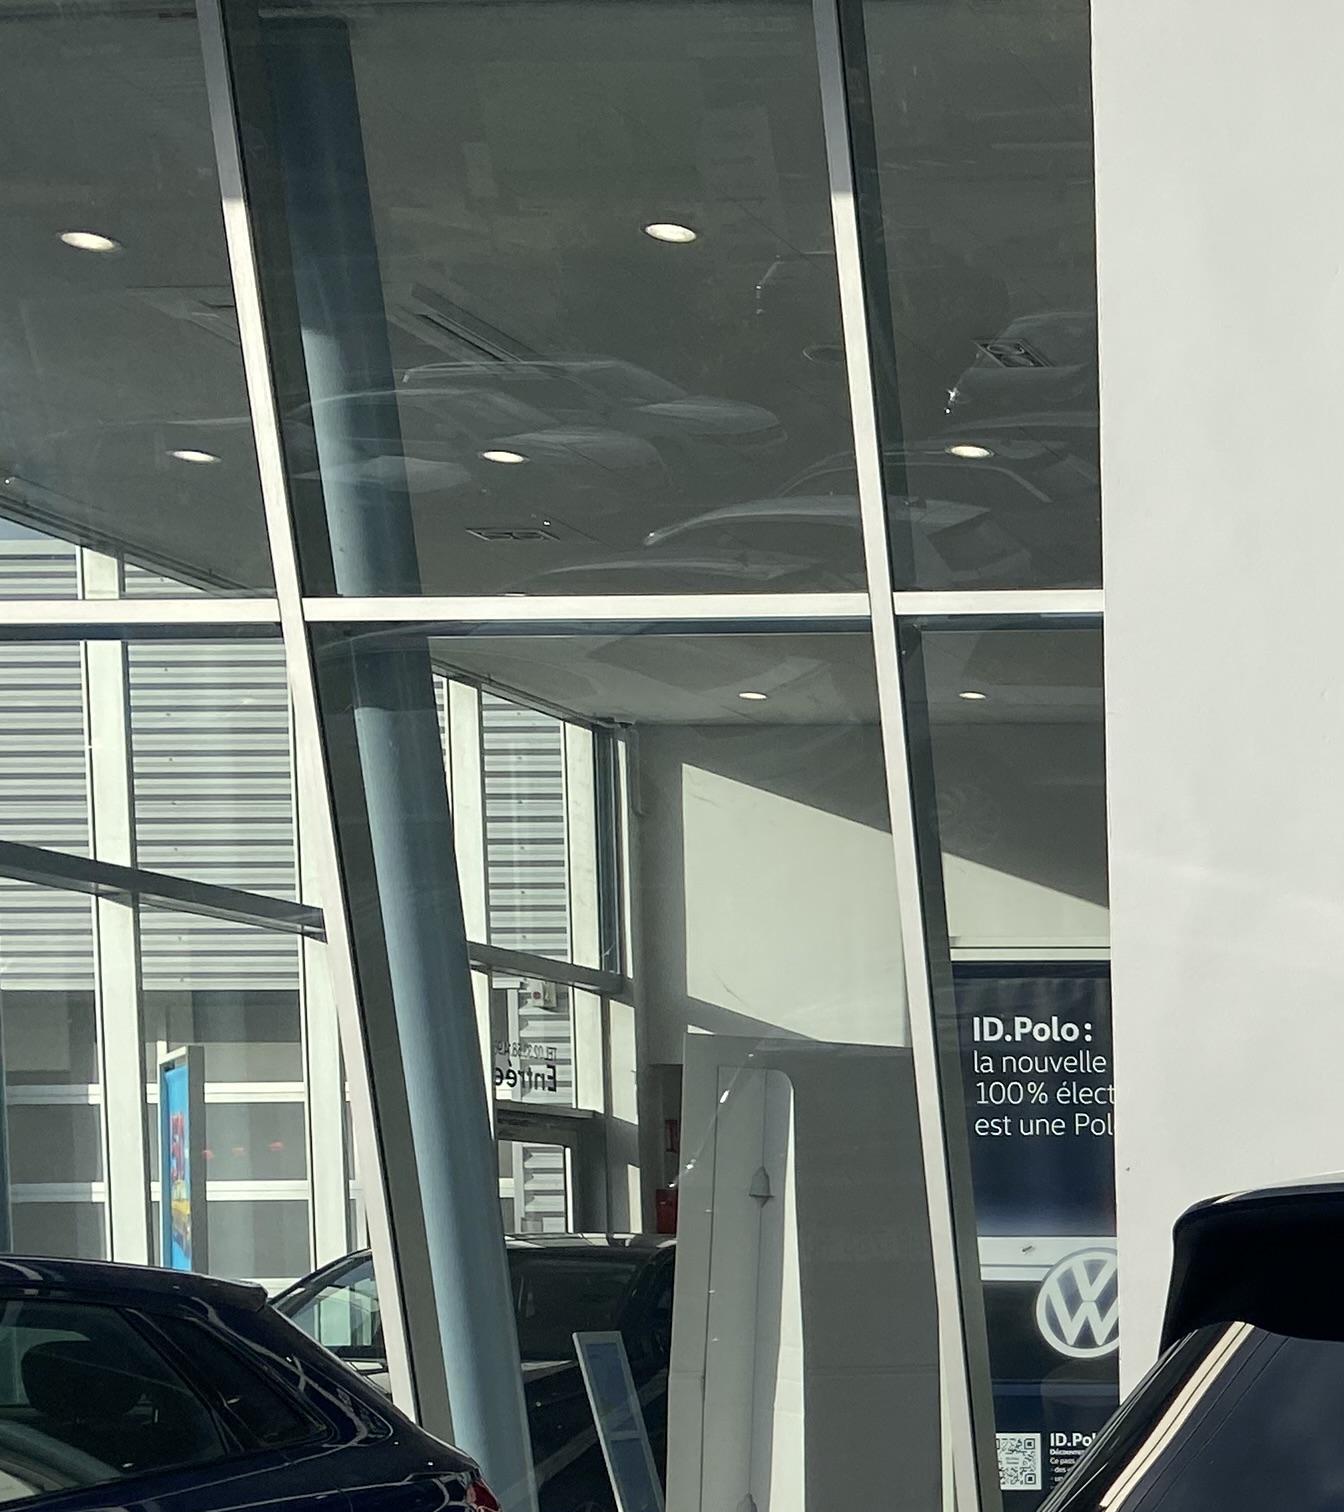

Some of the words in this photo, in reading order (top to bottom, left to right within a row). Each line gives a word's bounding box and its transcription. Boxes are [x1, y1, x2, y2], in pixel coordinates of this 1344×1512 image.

[973, 1050, 994, 1073] la
[1002, 1050, 1107, 1073] nouvelle
[974, 1116, 1012, 1136] est
[1020, 1118, 1066, 1136] une
